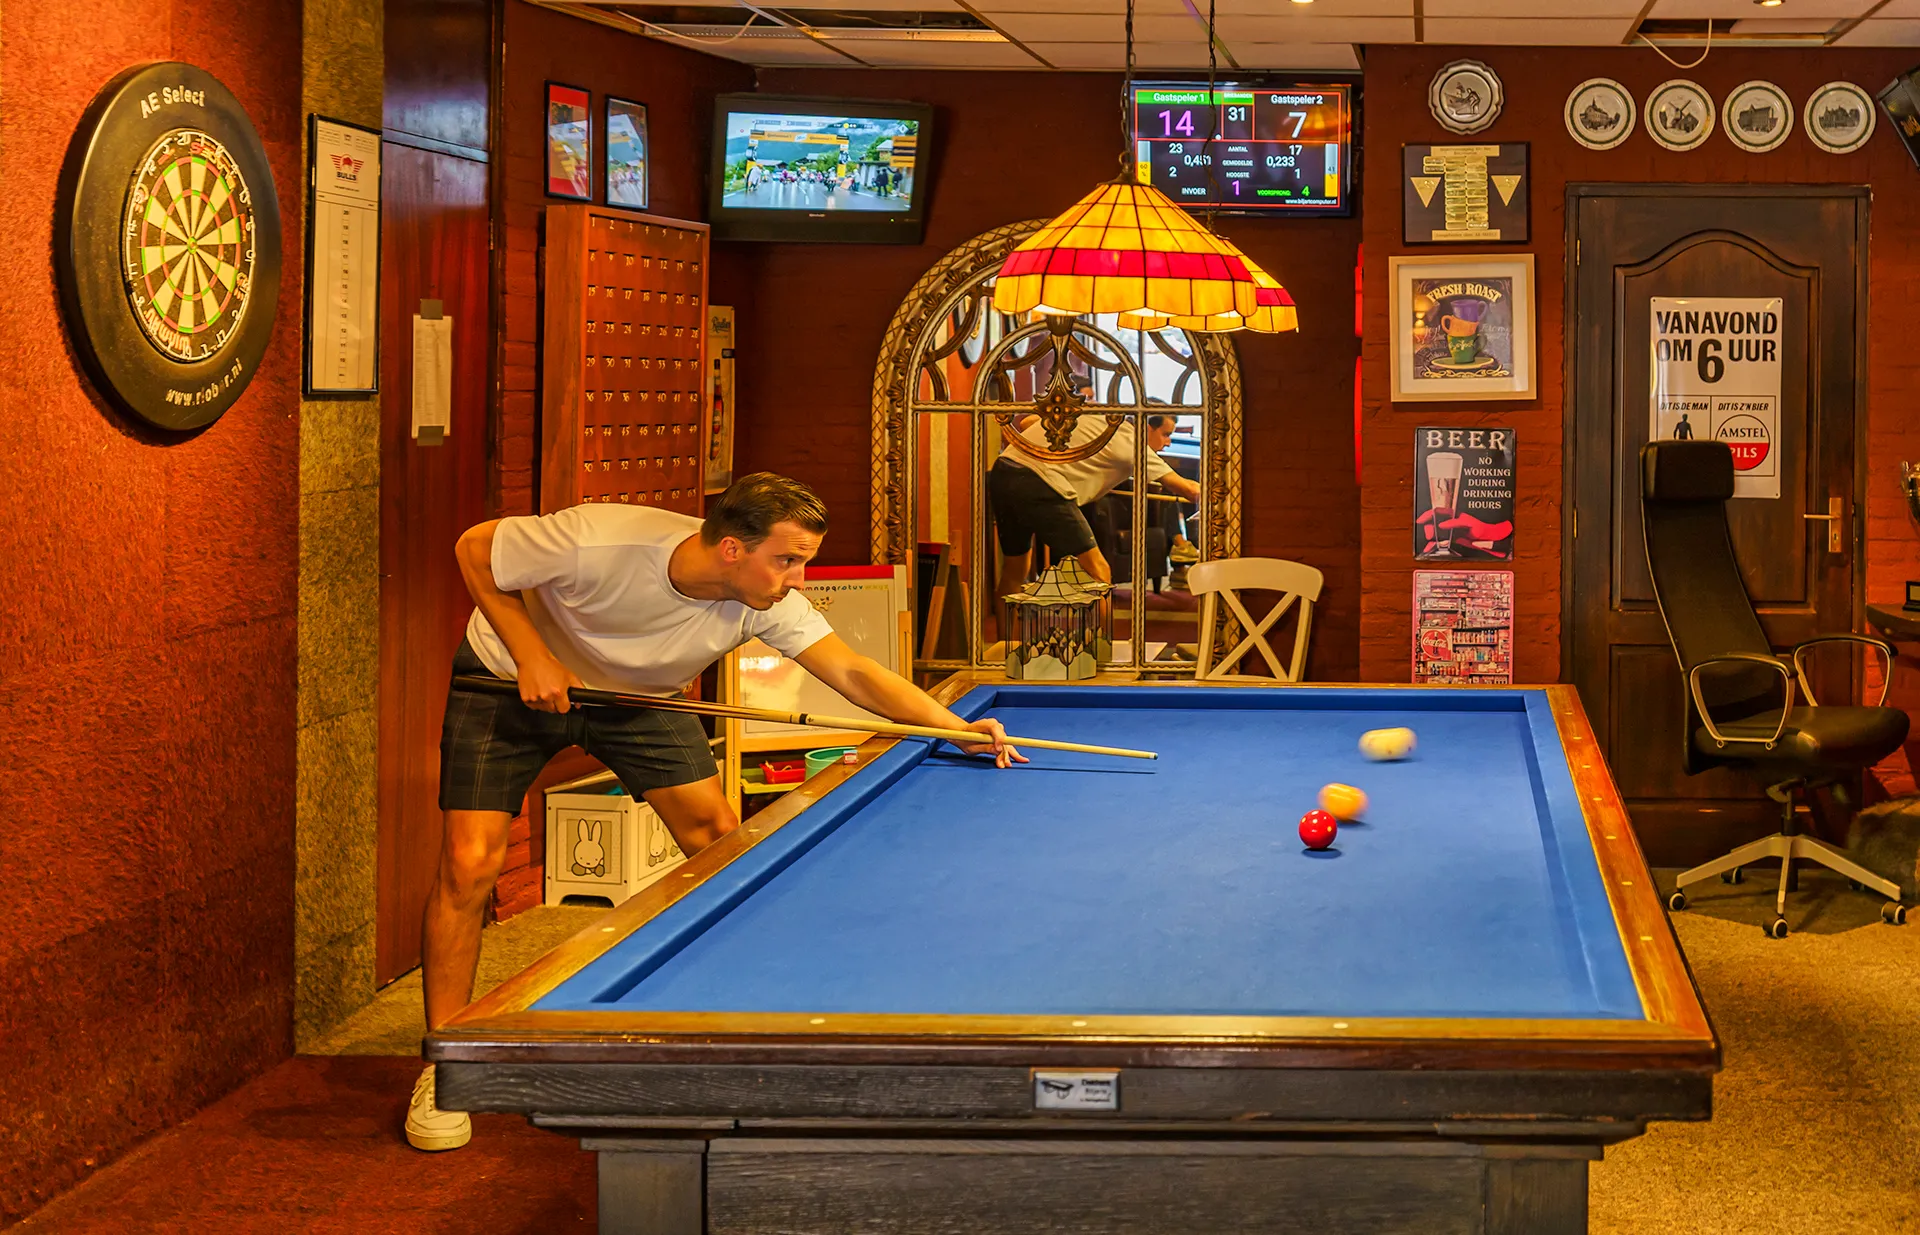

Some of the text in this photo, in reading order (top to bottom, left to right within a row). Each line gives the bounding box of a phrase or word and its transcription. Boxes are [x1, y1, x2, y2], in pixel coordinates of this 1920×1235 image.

[140, 85, 205, 118] AE Select
[1200, 93, 1205, 102] 1
[1316, 95, 1324, 104] 2
[1227, 106, 1246, 122] 31
[1158, 110, 1195, 137] 14
[1288, 111, 1307, 138] 7
[1168, 142, 1184, 154] 23
[1288, 144, 1303, 156] 17
[1265, 155, 1295, 168] 0,233
[1168, 165, 1177, 178] 2
[1294, 168, 1301, 179] 1
[1181, 187, 1207, 195] INVOER
[1231, 180, 1240, 196] 1
[1301, 185, 1311, 197] 4
[625, 256, 634, 266] 10
[643, 258, 650, 268] 11
[660, 260, 668, 270] 12
[588, 286, 596, 296] 15
[606, 288, 614, 298] 16
[624, 290, 632, 300] 17
[660, 293, 667, 303] 19
[675, 295, 684, 304] 20
[691, 296, 699, 306] 21
[1426, 282, 1502, 303] FRESH ROAST
[1656, 310, 1778, 335] VANAVOND
[587, 322, 596, 333] 22
[605, 323, 615, 334] 23
[641, 326, 651, 335] 25
[659, 327, 668, 336] 26
[675, 328, 684, 337] 27
[586, 357, 596, 367] 29
[606, 358, 615, 368] 30
[624, 359, 631, 369] 31
[641, 359, 650, 369] 32
[658, 360, 666, 370] 33
[690, 361, 698, 370] 35
[1656, 338, 1776, 384] OM 6 UUR
[586, 392, 594, 402] 36
[604, 392, 613, 402] 37
[640, 393, 648, 402] 39
[657, 393, 667, 402] 40
[673, 393, 681, 402] 41
[689, 393, 698, 402] 42
[1660, 402, 1709, 411] DIT IS DE MAN
[1718, 402, 1769, 411] DIT IS Z'N BIER
[584, 426, 593, 437] 43
[603, 427, 612, 437] 44
[621, 426, 630, 436] 45
[639, 426, 648, 436] 46
[656, 425, 665, 436] 47
[688, 425, 697, 433] 49
[1720, 427, 1766, 438] AMSTEL
[1426, 430, 1506, 451] BEER
[584, 462, 593, 472] 50
[602, 461, 610, 472] 51
[620, 460, 629, 470] 52
[638, 459, 647, 469] 53
[688, 457, 696, 466] 56
[1478, 457, 1493, 465] NO
[1463, 468, 1511, 477] WORKING
[1468, 479, 1506, 487] DURING
[655, 492, 663, 501] 61
[672, 490, 680, 499] 62
[1463, 490, 1512, 498] DRINKING
[1468, 500, 1502, 509] HOURS
